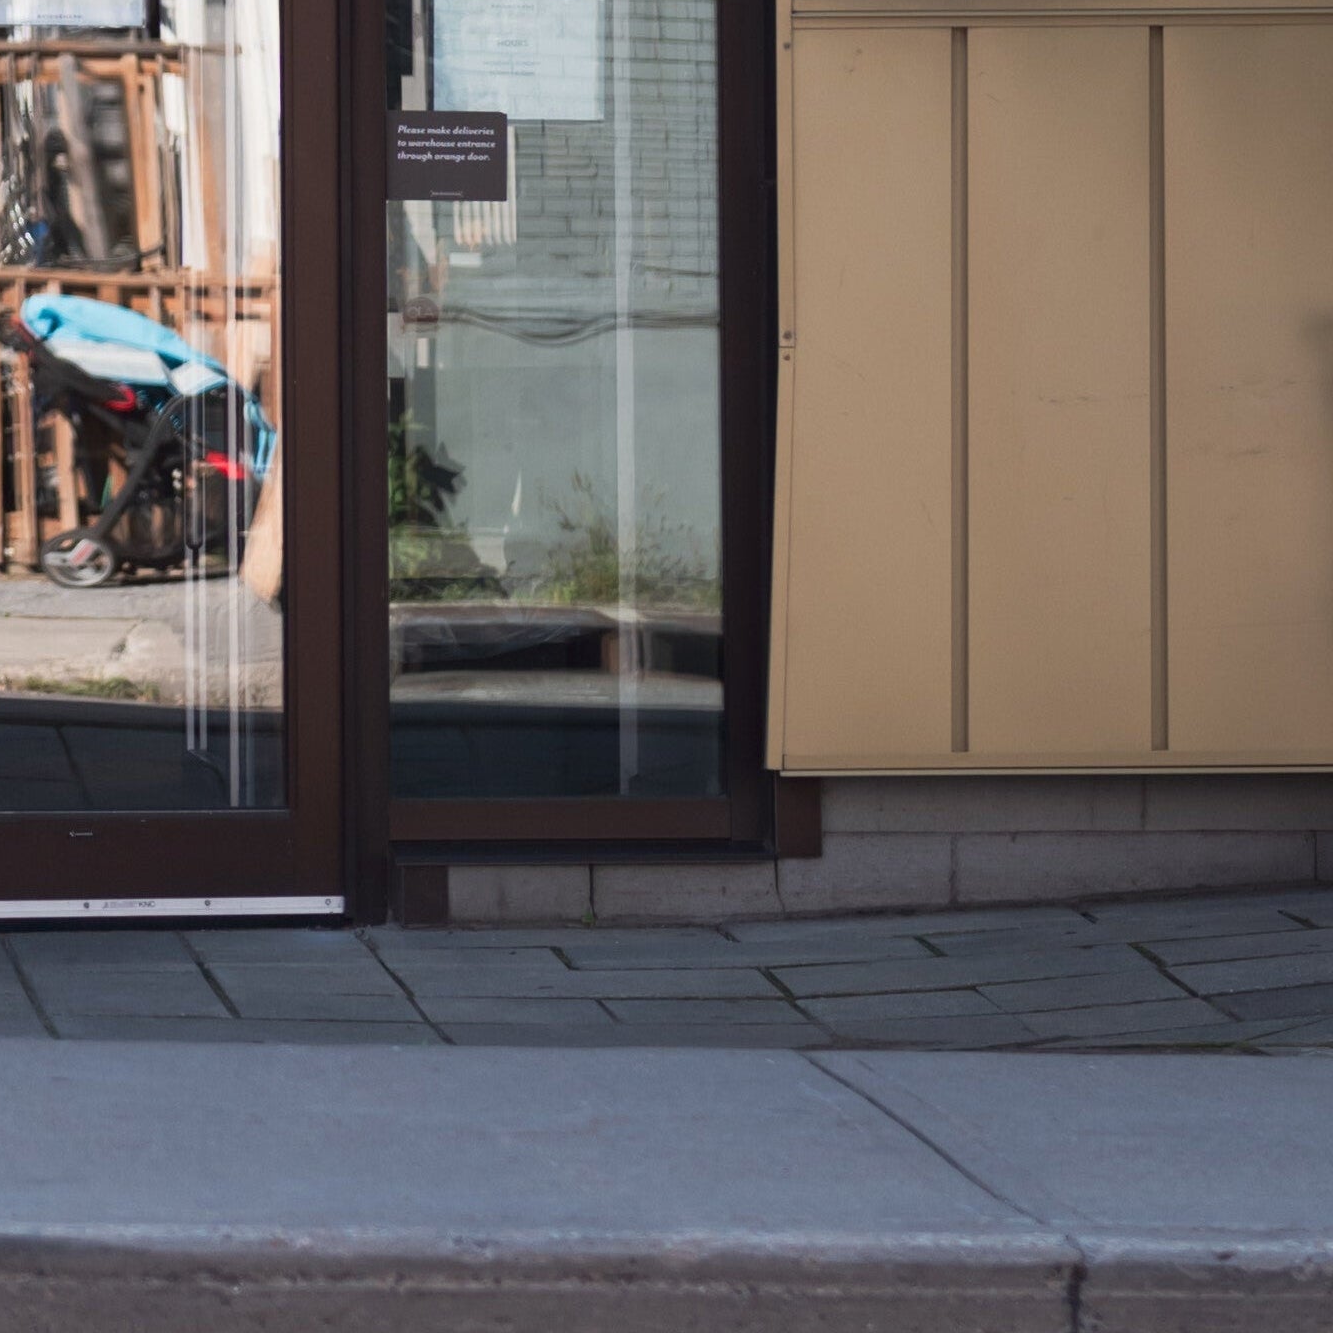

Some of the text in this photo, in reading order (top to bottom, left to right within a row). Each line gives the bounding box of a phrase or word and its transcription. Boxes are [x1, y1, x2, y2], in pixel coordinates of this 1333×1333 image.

[397, 124, 495, 136] Please make deliveries
[397, 138, 496, 148] to warehouse entrance
[397, 151, 491, 163] through orange door.
